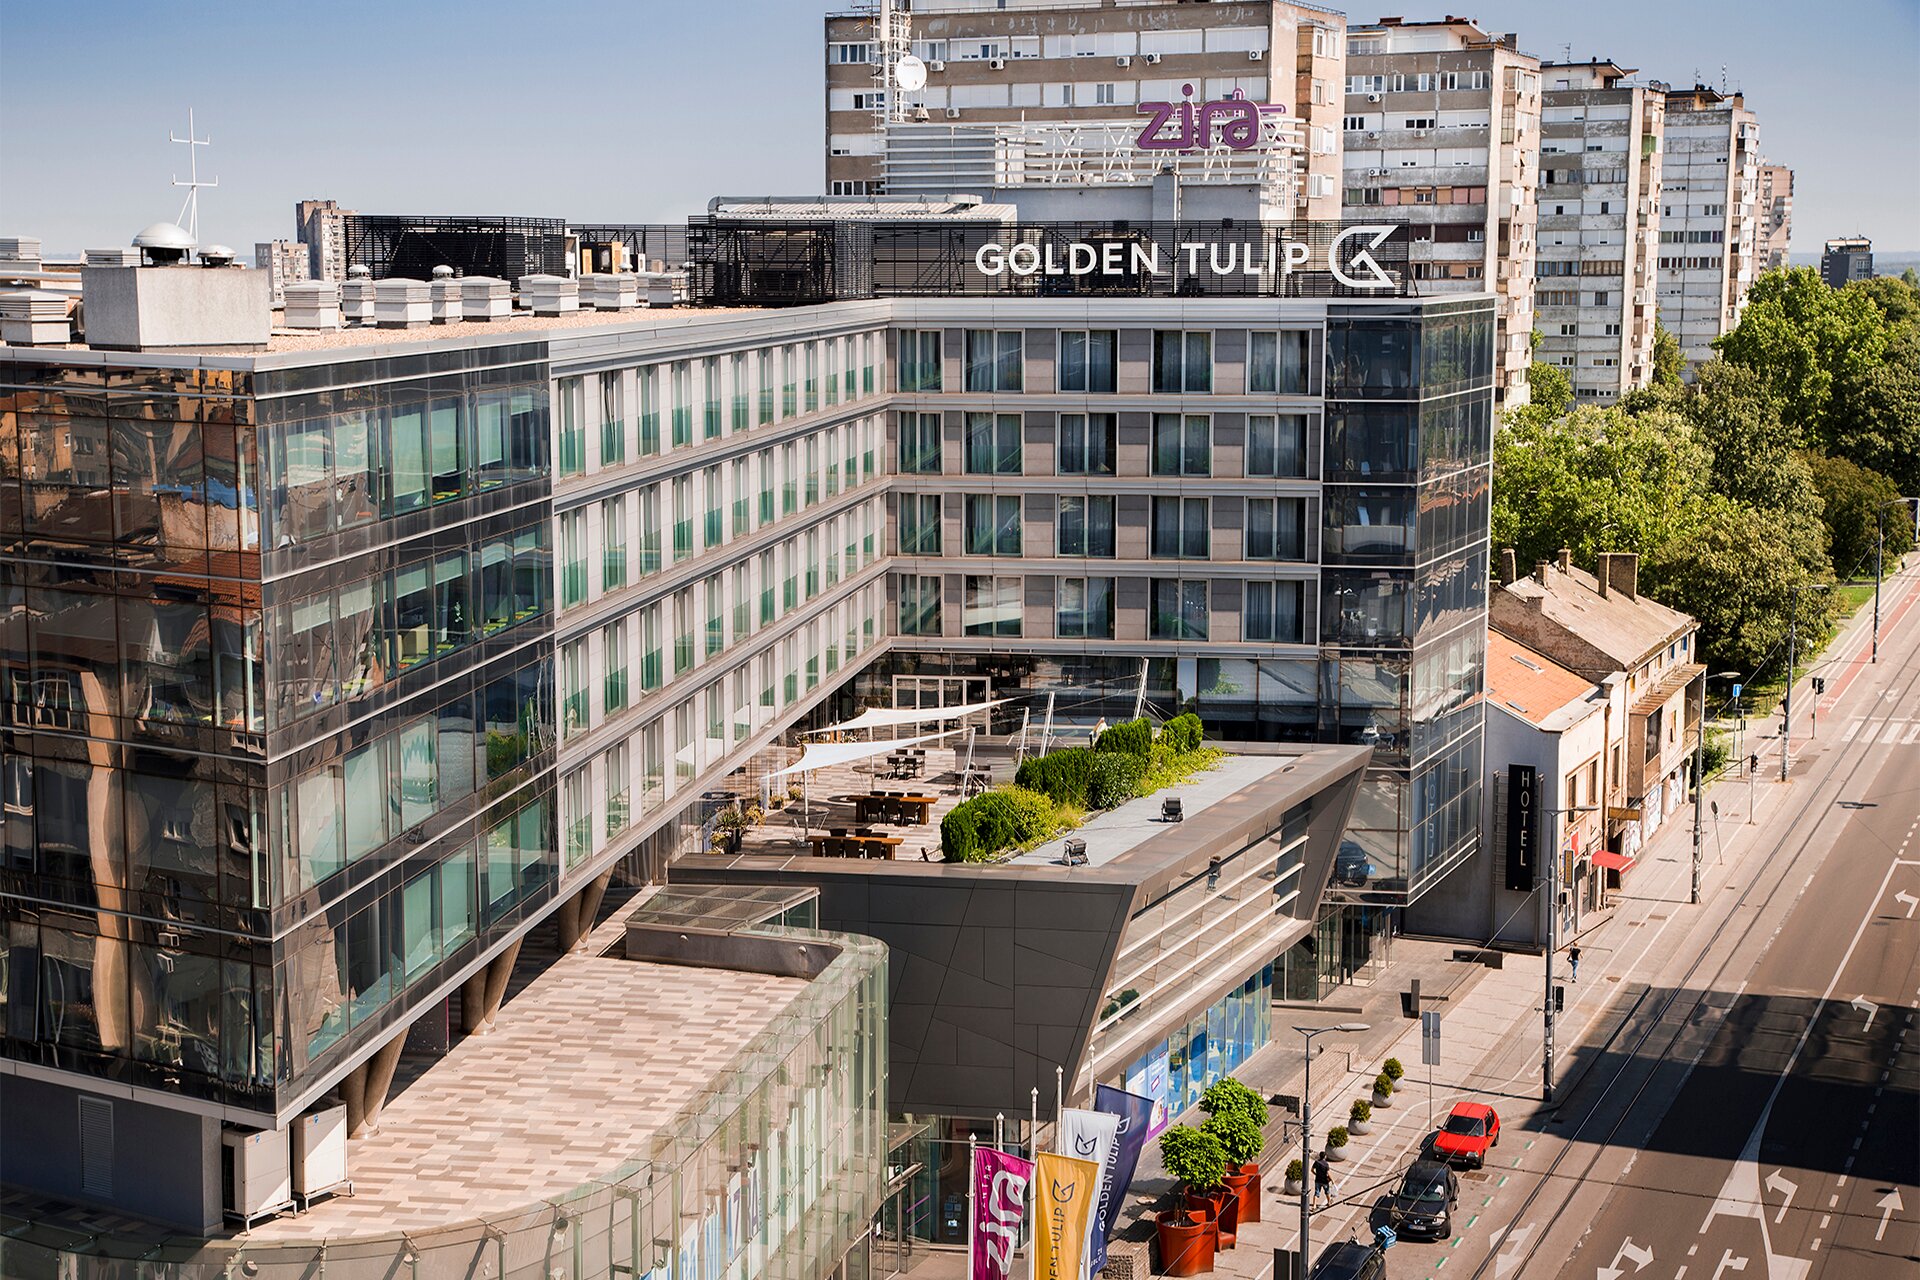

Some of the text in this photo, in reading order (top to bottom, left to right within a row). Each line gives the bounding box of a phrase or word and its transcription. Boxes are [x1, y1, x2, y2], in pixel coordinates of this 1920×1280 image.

[1137, 83, 1260, 150] zira
[975, 242, 1310, 276] GOLDEN TULIP
[1520, 771, 1530, 866] HOTEL
[1051, 1207, 1064, 1252] TULIP
